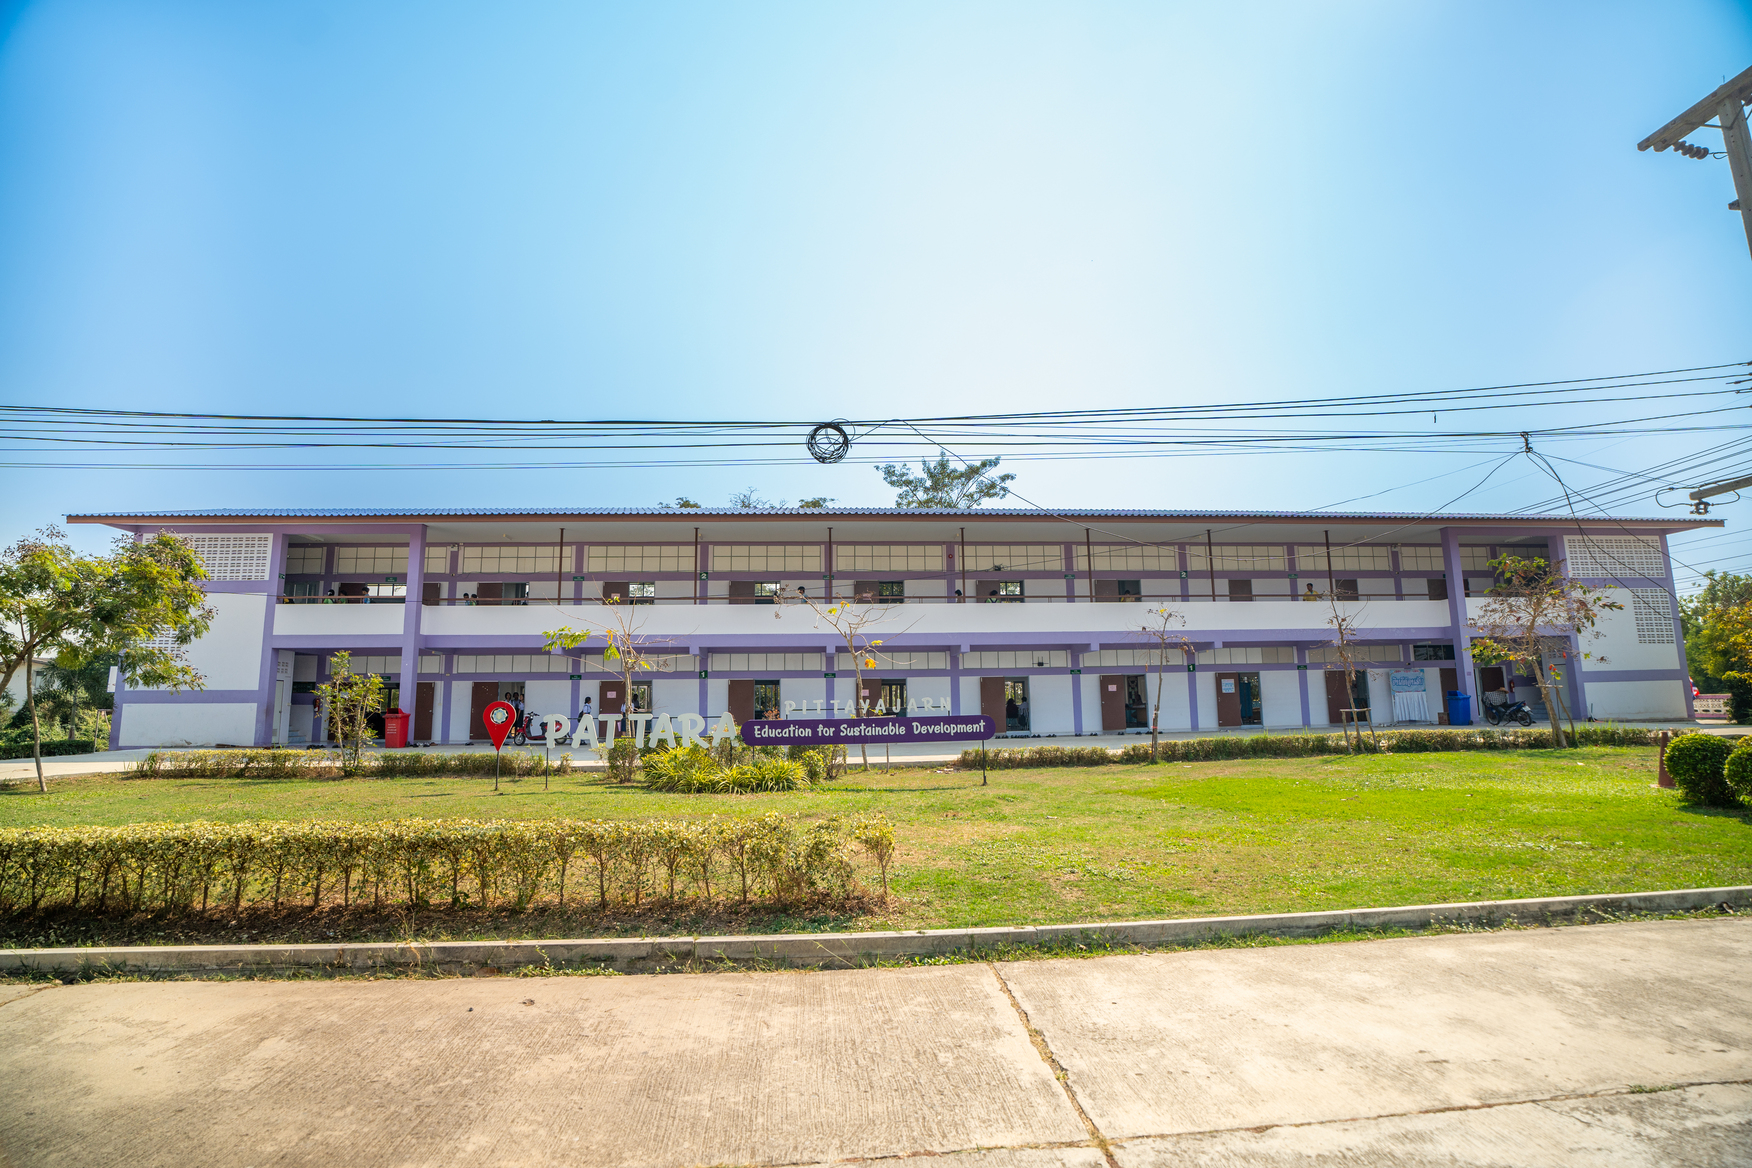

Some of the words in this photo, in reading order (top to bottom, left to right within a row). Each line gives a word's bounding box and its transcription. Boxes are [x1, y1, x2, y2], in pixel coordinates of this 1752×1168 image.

[784, 697, 951, 715] PITTAYAJARN
[543, 711, 739, 749] PATTARA
[754, 725, 812, 738] Education
[817, 724, 835, 736] for
[840, 722, 906, 736] Sustainable
[912, 719, 985, 736] Development
